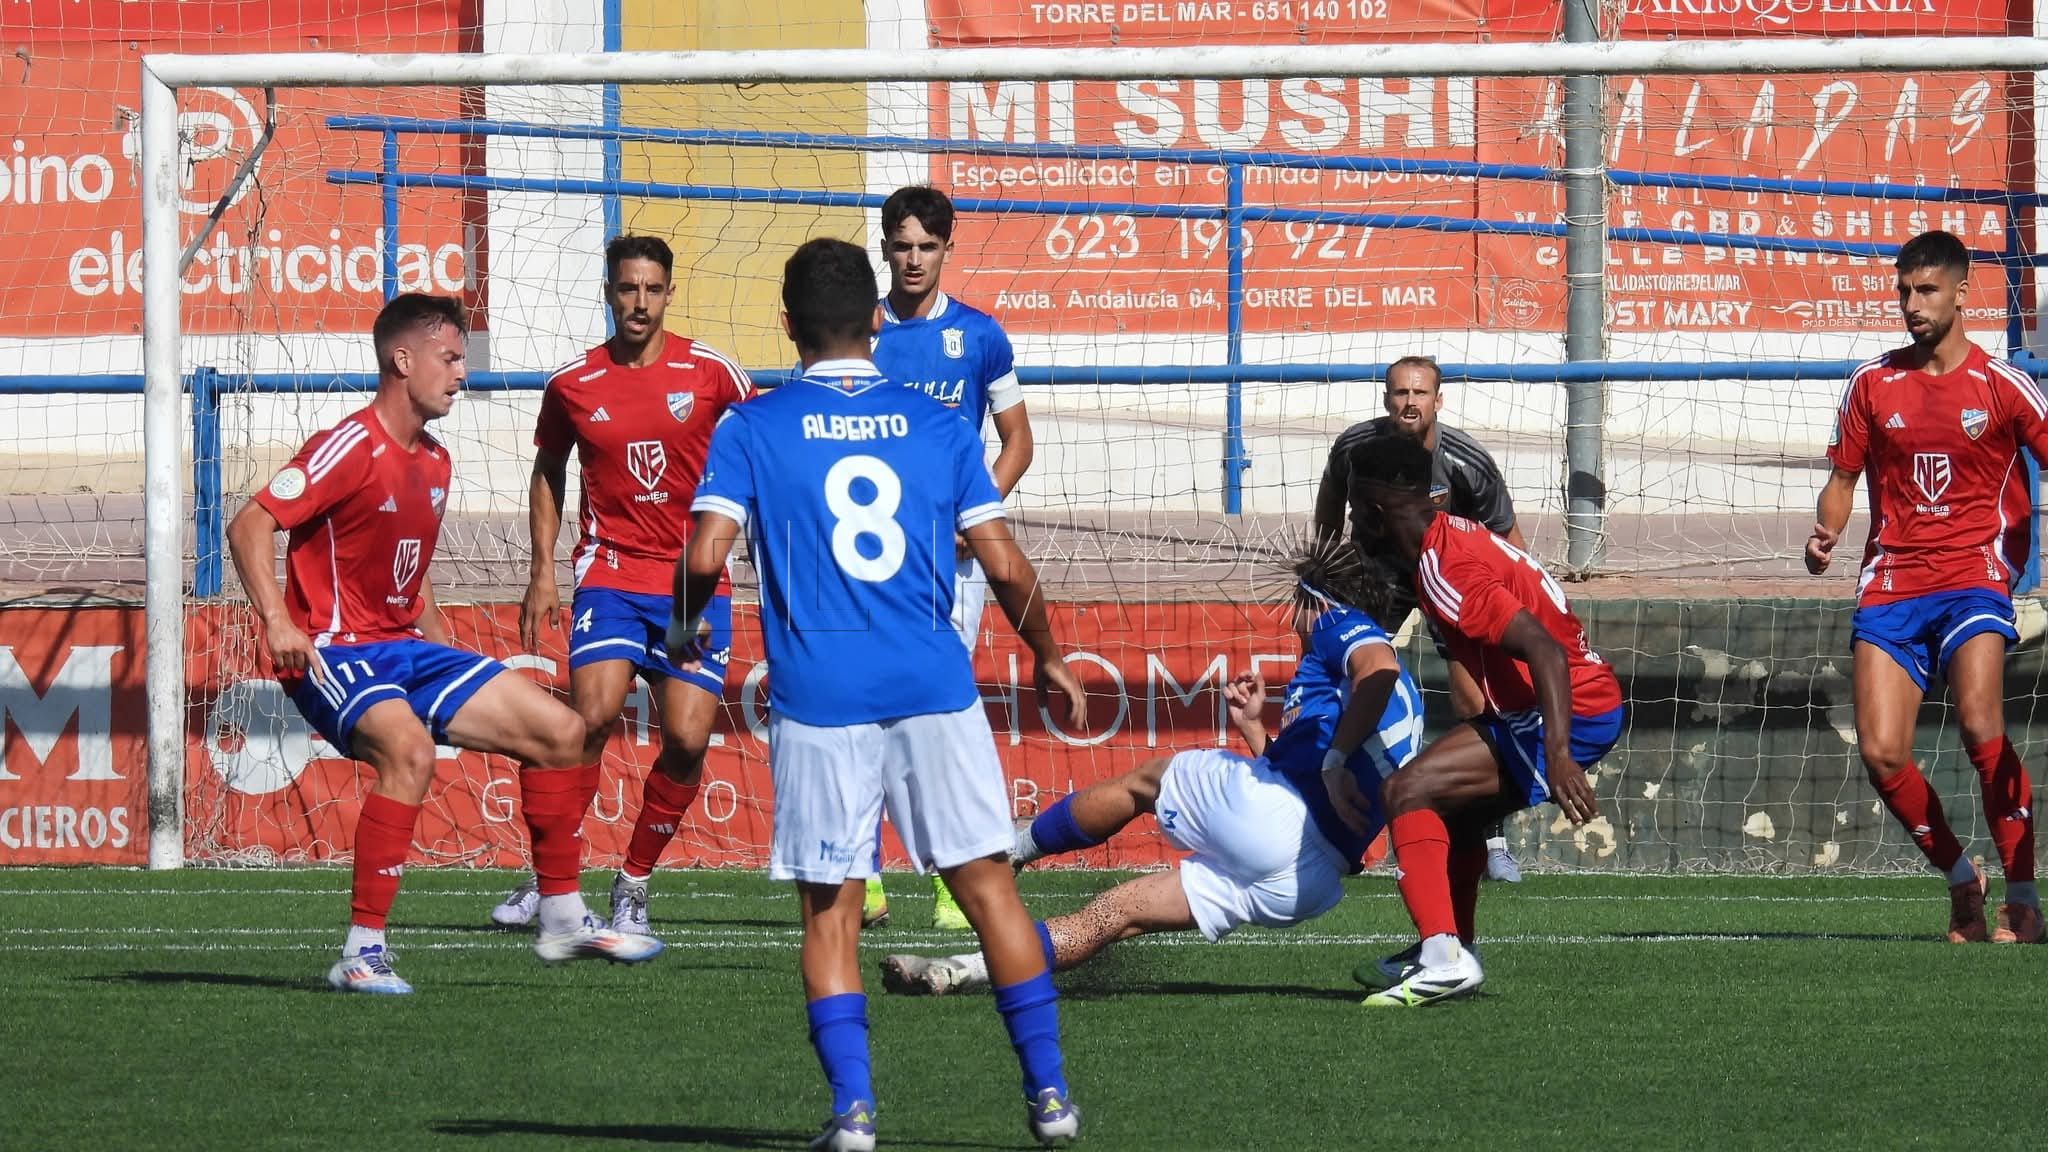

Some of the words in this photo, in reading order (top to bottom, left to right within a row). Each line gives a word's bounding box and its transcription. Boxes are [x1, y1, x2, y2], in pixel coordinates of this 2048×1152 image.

[1031, 3, 1116, 24] TORRE
[1122, 2, 1171, 22] DEL
[1177, 1, 1232, 21] MAR
[1252, 0, 1291, 21] 651
[1300, 0, 1340, 20] 140
[1348, 0, 1388, 19] 102
[948, 78, 1077, 145] MI
[1114, 76, 1475, 150] SUSHI
[0, 139, 114, 203] ino
[952, 158, 1138, 191] Especialidad
[1154, 164, 1191, 186] en
[1206, 164, 1319, 185] cmida
[1811, 209, 2003, 238] SHISHA
[1045, 215, 1140, 261] 623
[1536, 246, 1685, 267] CLLE
[1606, 274, 1741, 292] ALADASTORREDELMAR
[1831, 275, 1857, 292] TEL.
[1863, 274, 1886, 292] 951
[994, 290, 1056, 310] Avda.
[1067, 287, 1178, 309] Andalucía
[1189, 288, 1221, 311] 64,
[1324, 286, 1372, 307] DEL
[1382, 285, 1437, 306] MAR
[1664, 300, 1752, 326] MARY
[1802, 318, 1827, 329] POD
[803, 414, 908, 441] ALBERTO
[825, 454, 906, 583] 8
[337, 659, 376, 685] 11
